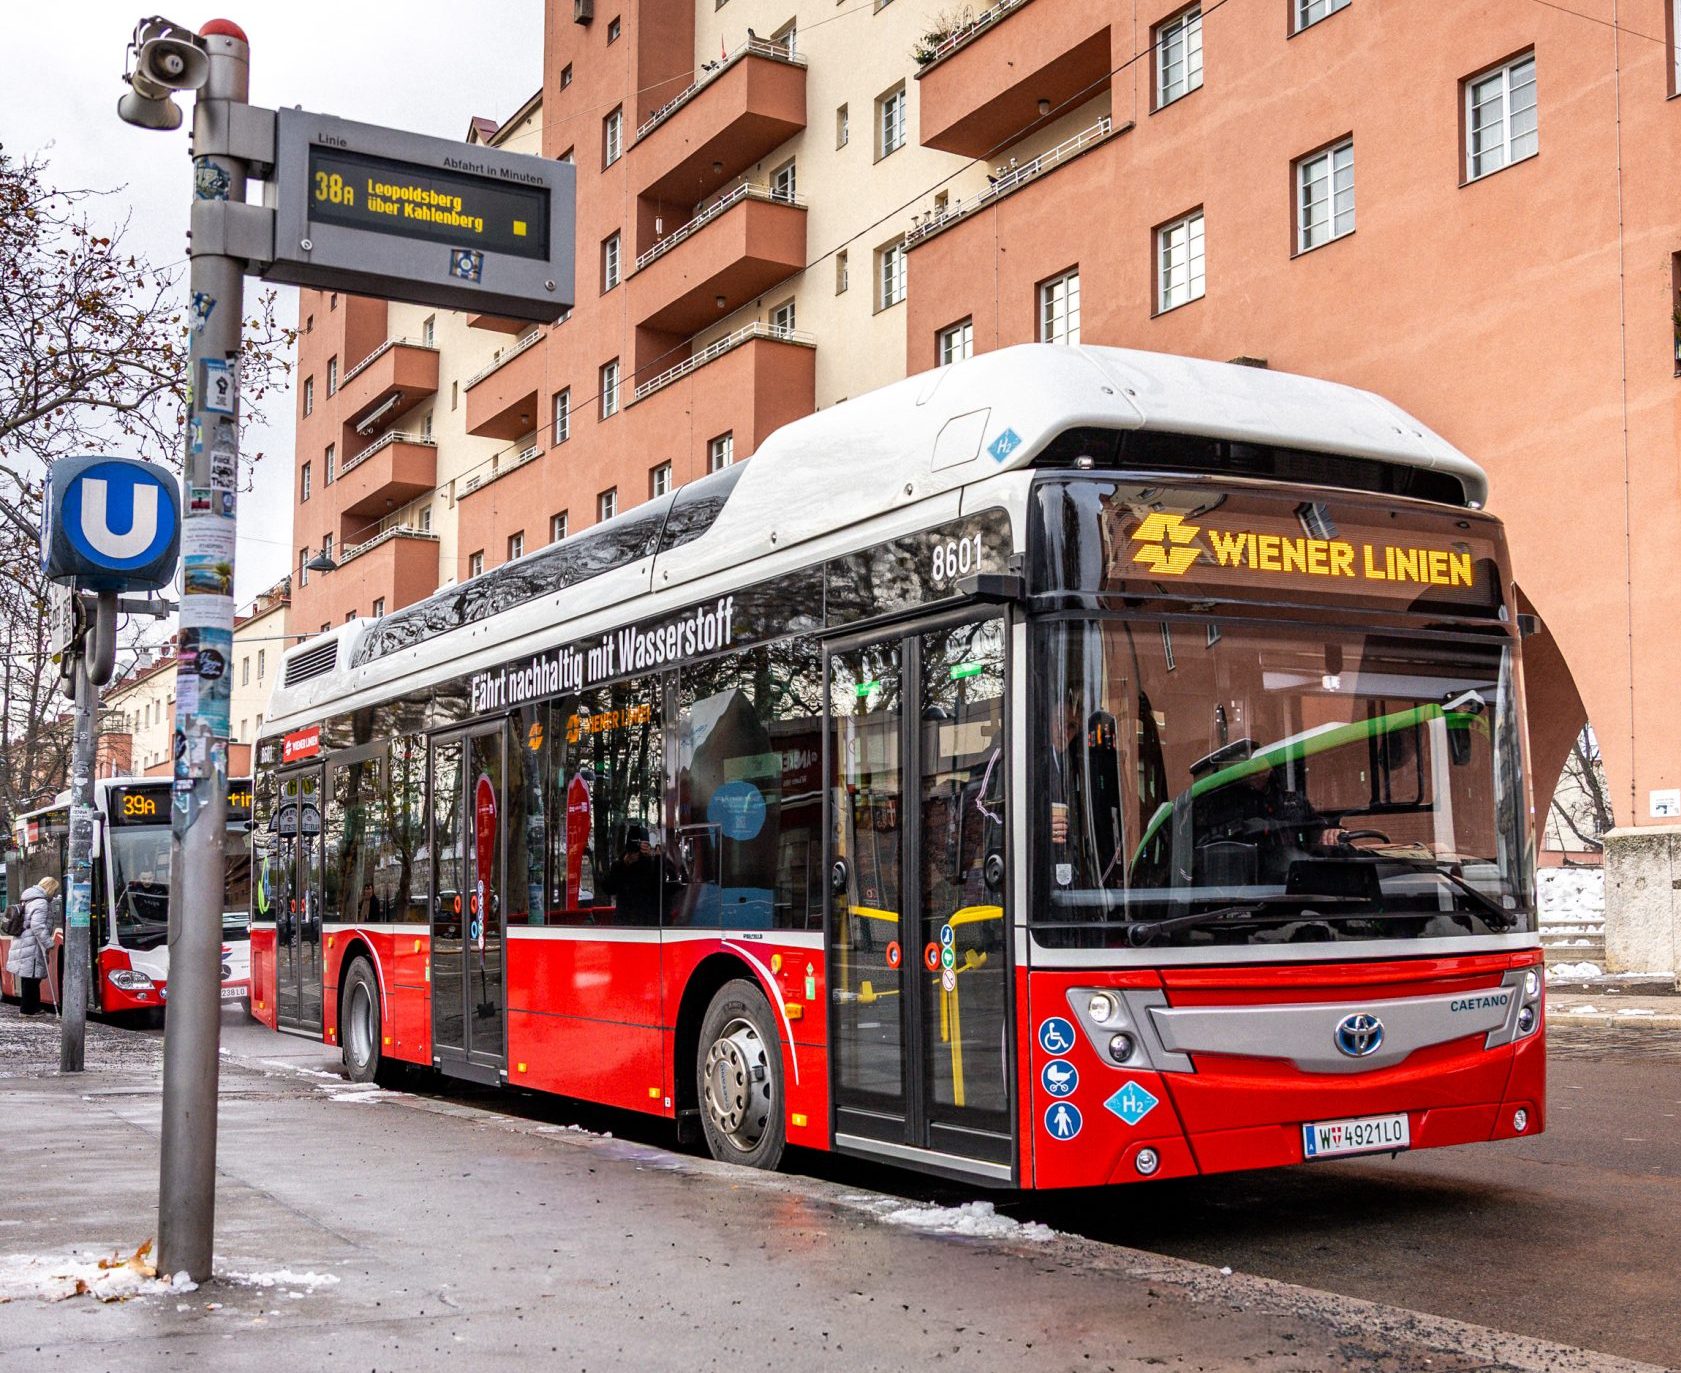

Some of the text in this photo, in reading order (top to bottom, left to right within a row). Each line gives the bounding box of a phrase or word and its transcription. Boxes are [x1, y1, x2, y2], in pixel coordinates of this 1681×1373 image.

[318, 133, 348, 147] Linie
[443, 157, 544, 185] Abfahrt in Minuten
[315, 171, 354, 206] 38A
[367, 178, 462, 212] Leopoldsberg
[367, 196, 484, 233] über Kahlenberg
[80, 477, 158, 559] U
[932, 533, 982, 581] 8601
[1208, 529, 1473, 587] WIENER LINIEN
[471, 596, 734, 713] Fährt nachhaltig mit Wasserstoff
[122, 795, 156, 815] 39A
[221, 988, 245, 998] 238LO
[1450, 994, 1508, 1013] CAETANO
[1319, 1127, 1331, 1149] W
